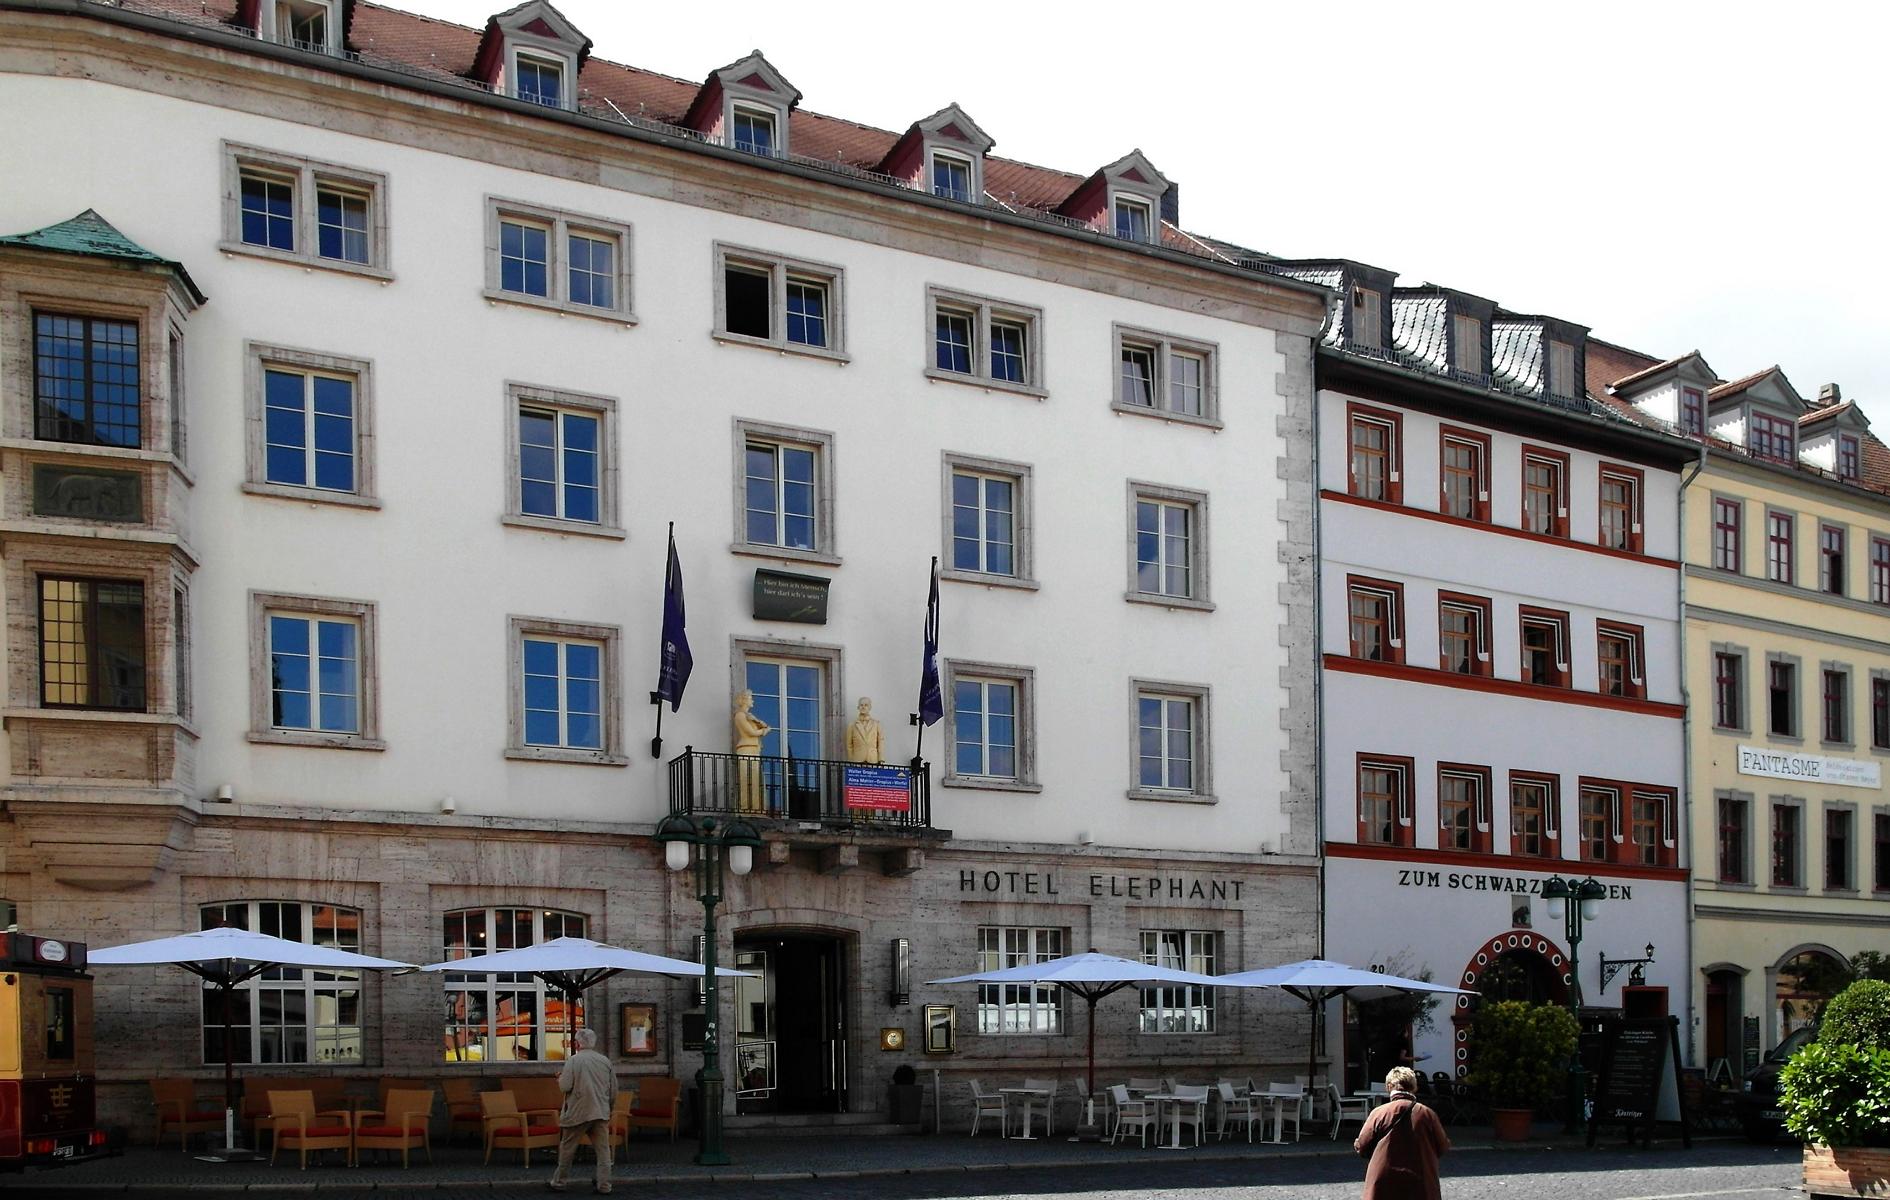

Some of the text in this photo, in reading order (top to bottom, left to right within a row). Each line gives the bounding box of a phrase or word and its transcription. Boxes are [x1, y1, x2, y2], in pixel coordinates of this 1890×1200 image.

[1742, 751, 1820, 777] FANTASME
[960, 869, 1244, 900] HOTEL ELEPHANT
[1399, 870, 1441, 888] ZUM
[1448, 873, 1548, 895] SCHWARZ
